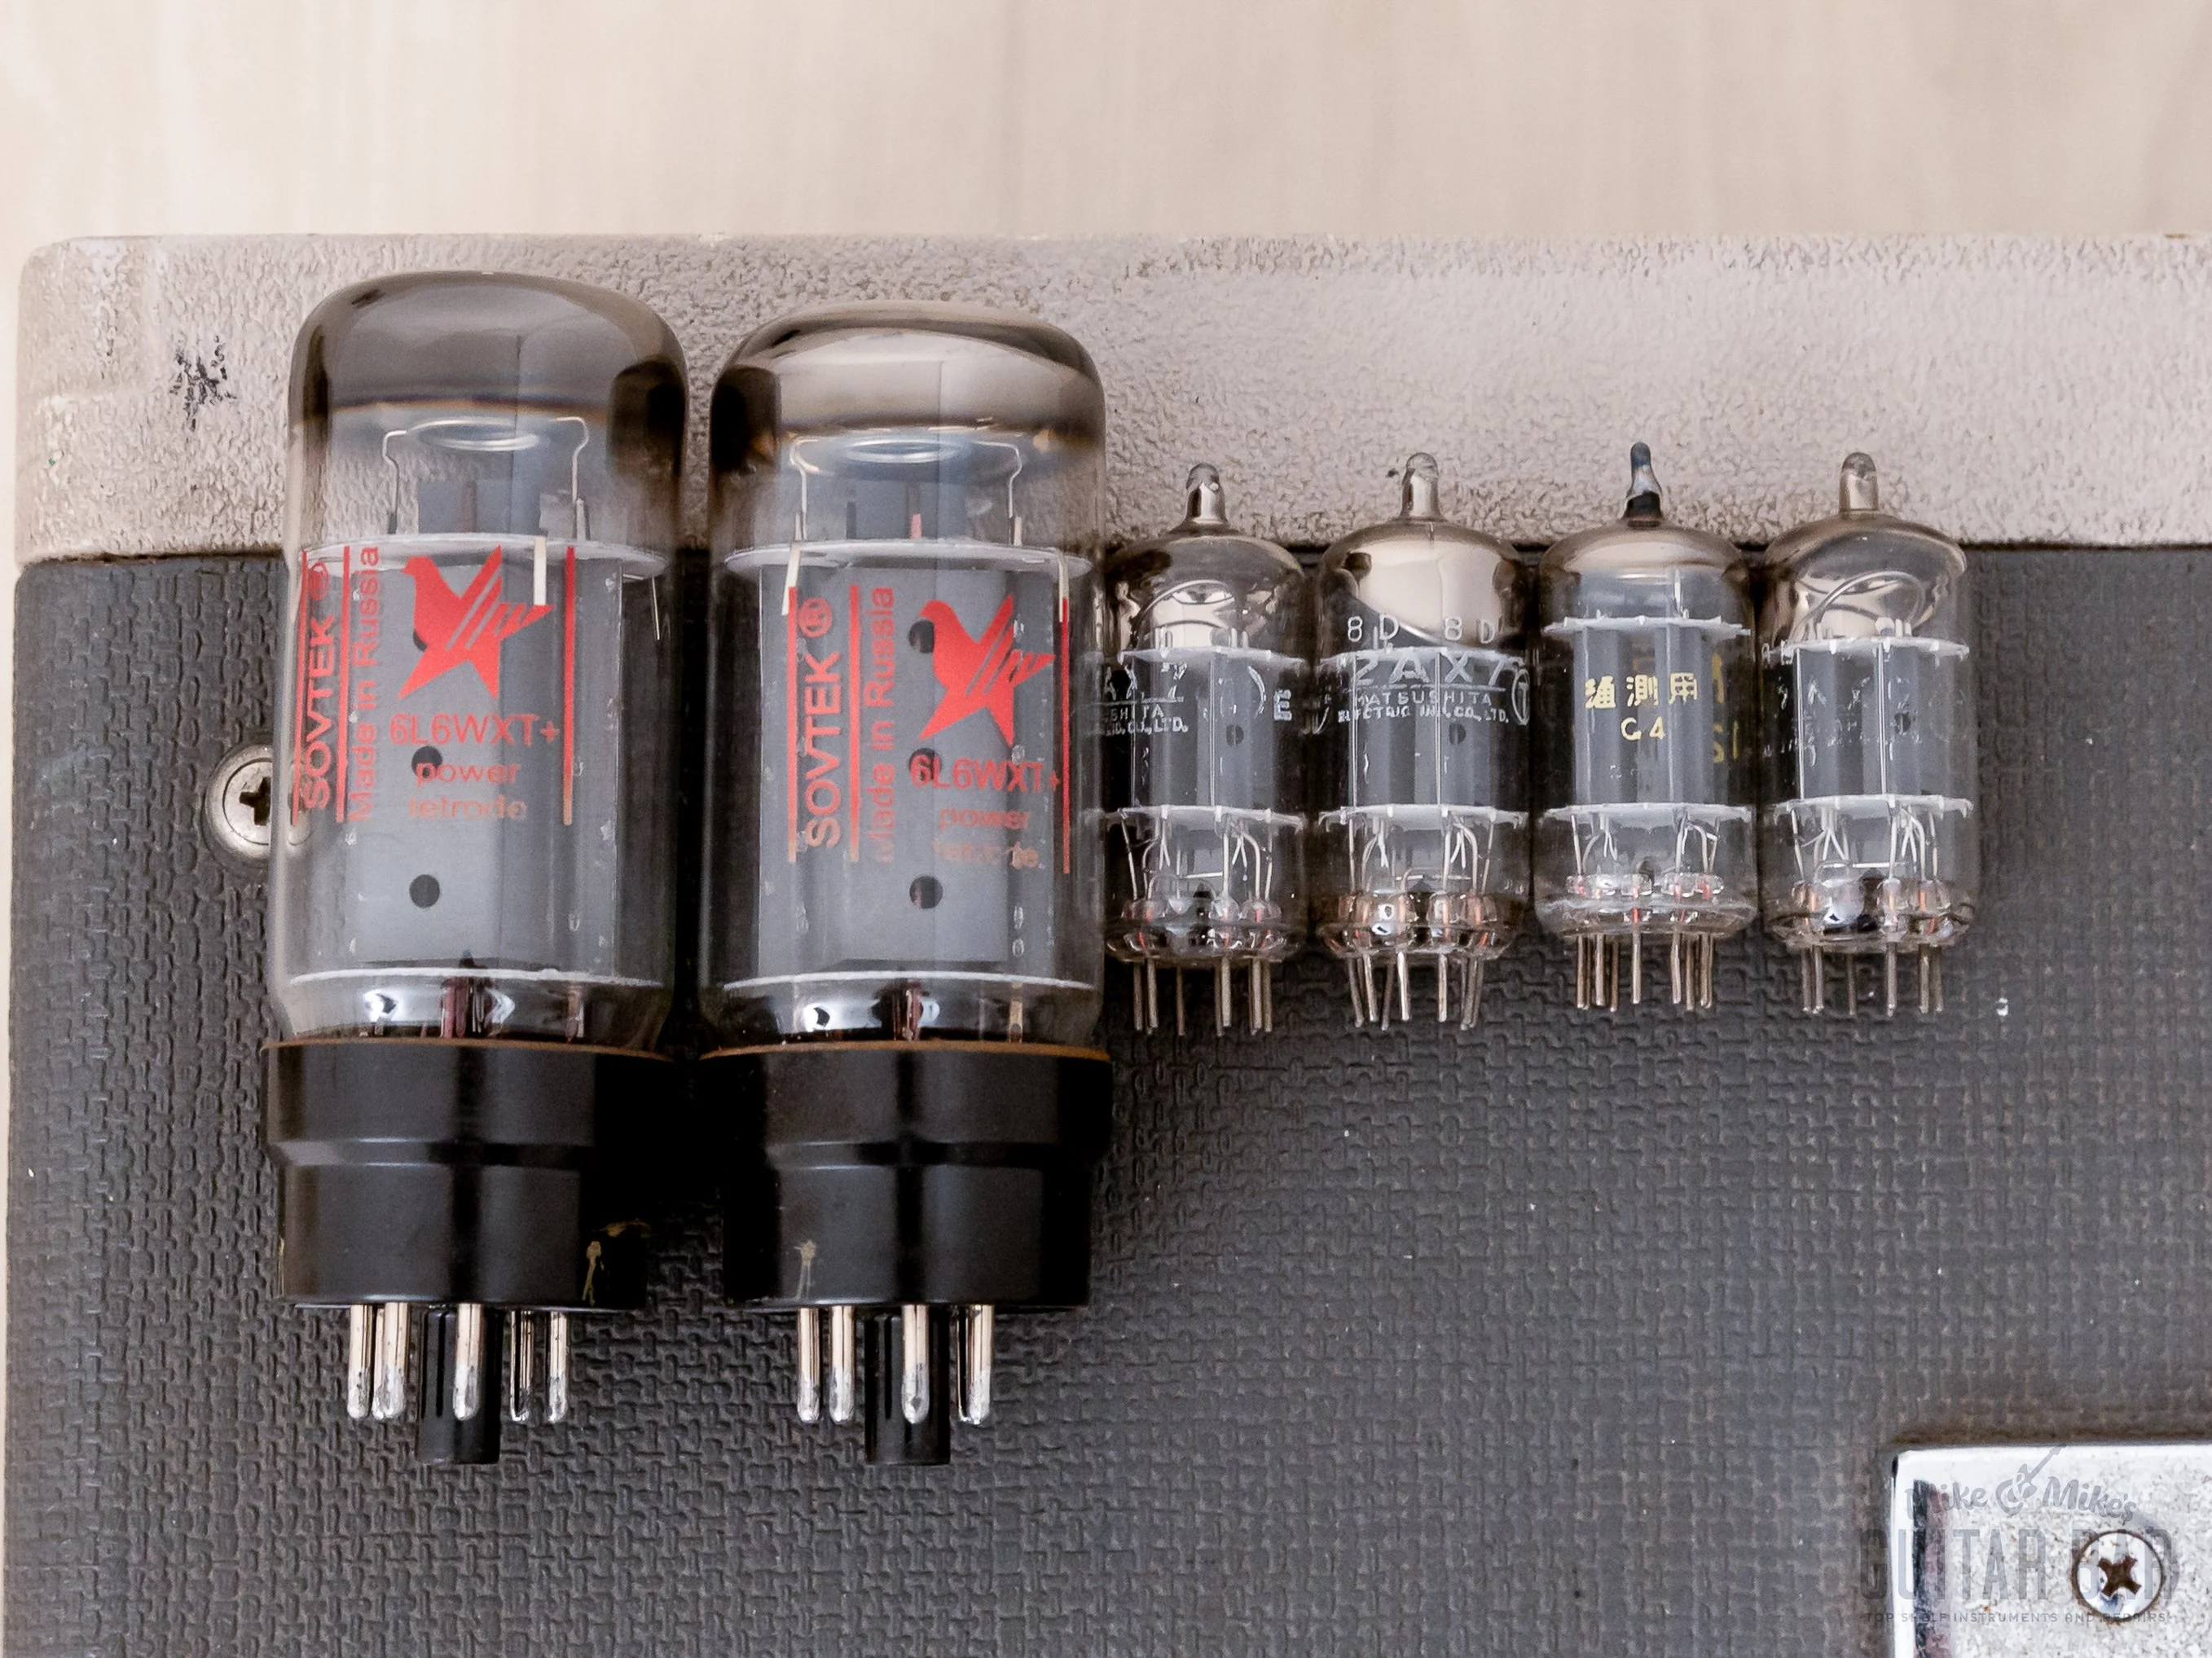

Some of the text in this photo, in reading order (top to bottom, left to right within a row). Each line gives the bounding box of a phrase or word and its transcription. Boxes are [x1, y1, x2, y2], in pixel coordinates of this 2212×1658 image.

[349, 546, 379, 821] Made in Russia
[864, 587, 895, 707] Russia
[304, 614, 334, 809] SOVTEK
[389, 711, 561, 746] 6L6WXT+
[805, 651, 842, 848] SOVTEK
[872, 719, 895, 750] in
[416, 759, 523, 789] power
[910, 754, 1061, 793] 6L6WXT+
